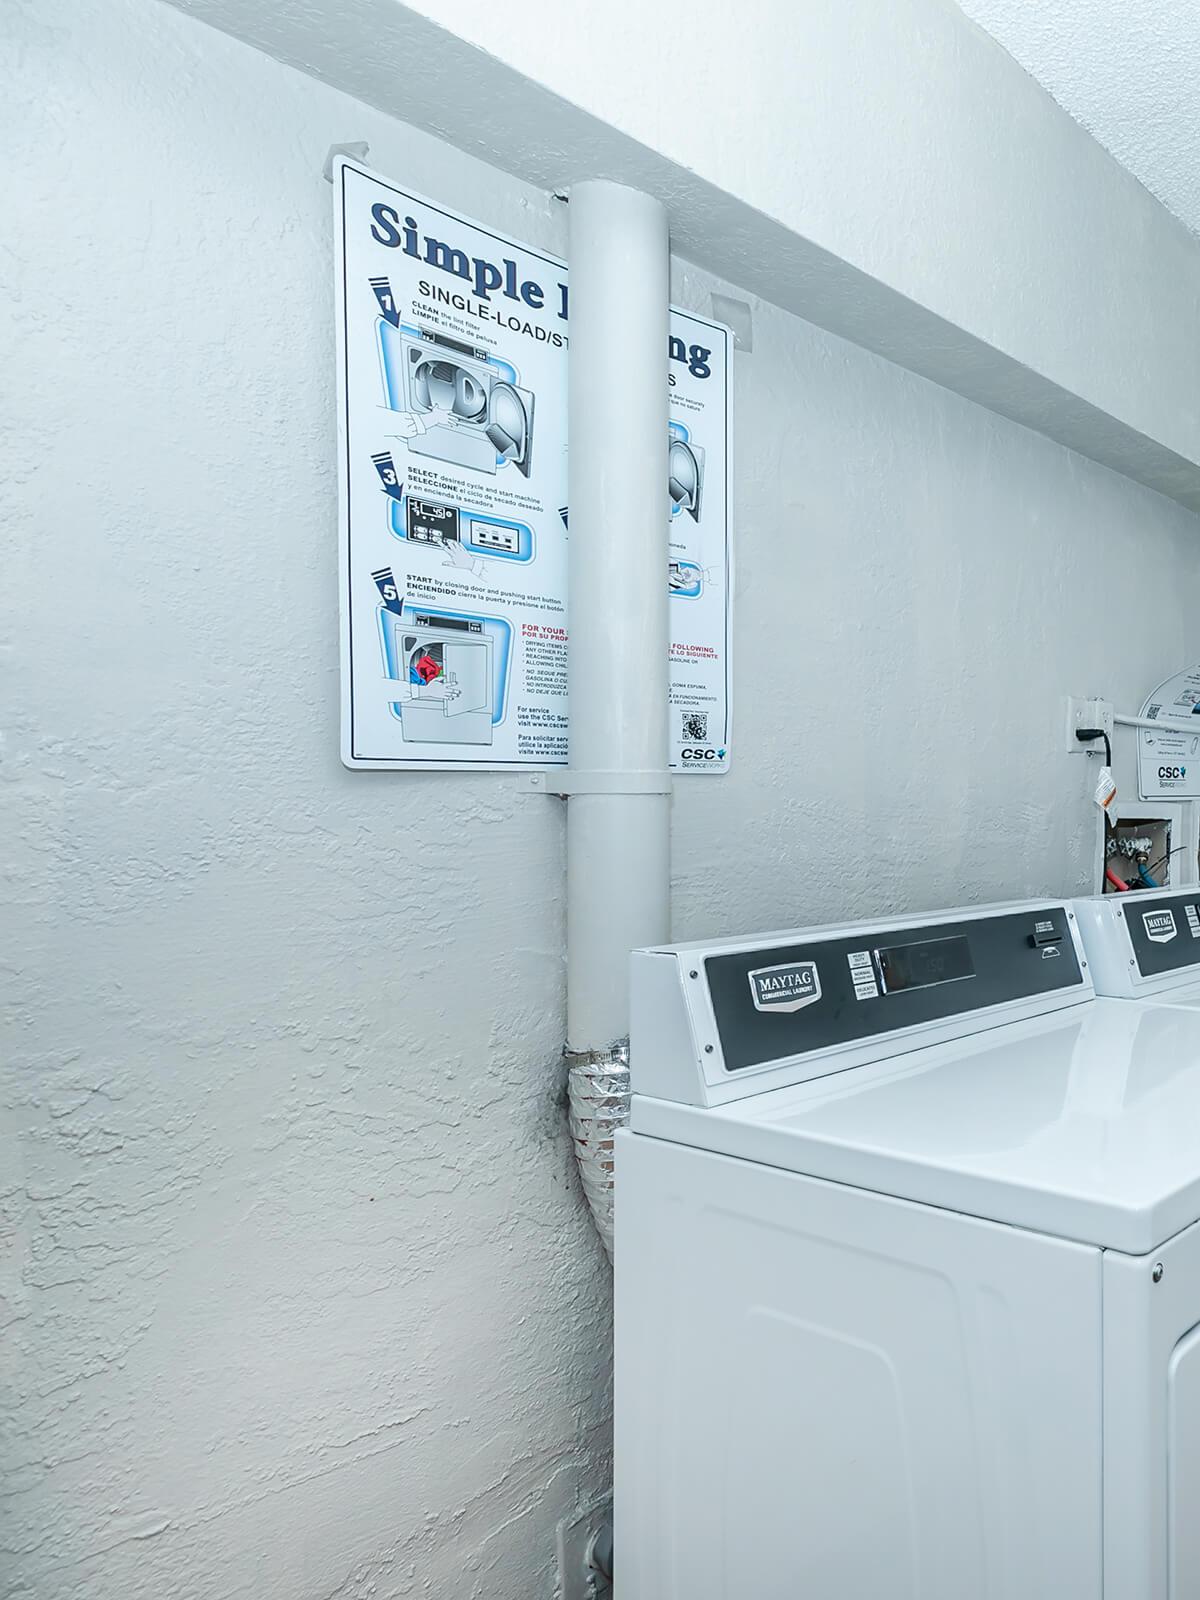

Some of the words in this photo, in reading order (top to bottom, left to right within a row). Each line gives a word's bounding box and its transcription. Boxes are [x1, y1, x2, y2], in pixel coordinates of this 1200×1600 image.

[370, 203, 545, 309] Simple
[381, 294, 392, 312] 1
[412, 300, 439, 315] CLEAN
[441, 312, 452, 320] the
[453, 316, 464, 325] lint
[465, 321, 480, 331] filter
[412, 308, 439, 324] LIMPIE
[449, 322, 465, 333] filtro
[466, 329, 474, 337] de
[476, 334, 498, 345] pelusa
[382, 468, 397, 485] 3
[408, 466, 438, 479] SELECT
[440, 475, 465, 486] desired
[467, 482, 484, 490] cycle
[499, 490, 513, 498] start
[515, 494, 540, 504] machine
[408, 474, 458, 492] SELECCIONE
[467, 489, 482, 498] ciclo
[494, 497, 516, 506] secado
[518, 502, 544, 512] deseado
[424, 487, 454, 499] encienda
[464, 497, 493, 508] secadora
[383, 585, 397, 599] 5
[407, 574, 432, 583] START
[445, 581, 469, 591] closing
[501, 590, 526, 600] pushing
[407, 582, 457, 596] ENCIENDIDO
[458, 591, 477, 599] cierre
[486, 596, 506, 604] puerta
[513, 600, 539, 609] presione
[417, 592, 436, 600] inicio
[522, 624, 539, 632] FOR
[542, 626, 566, 635] YOUR
[672, 643, 714, 653] FOLLOWING
[526, 653, 554, 661] REACHING
[686, 651, 718, 659] SIGUIENTE
[681, 748, 716, 760] CSC
[1158, 766, 1180, 778] CSC
[1147, 916, 1172, 928] MAYTAG
[758, 971, 811, 991] MAYTAG
[761, 990, 793, 1000] COMMERCIAL
